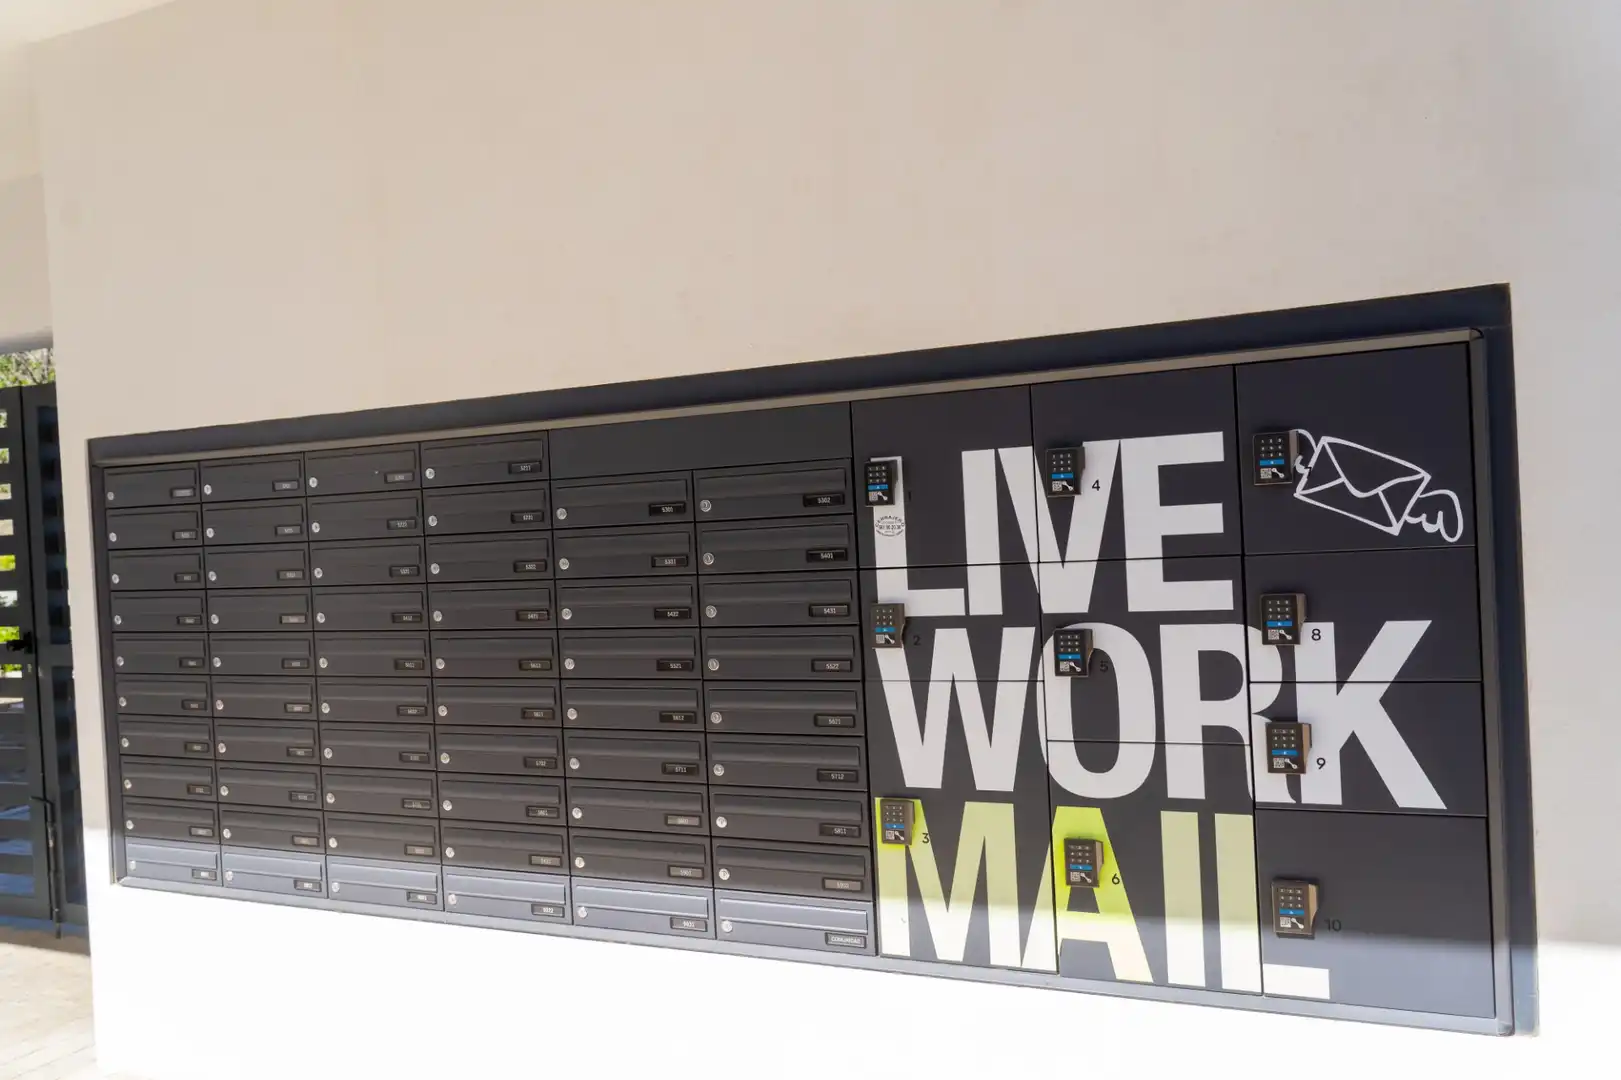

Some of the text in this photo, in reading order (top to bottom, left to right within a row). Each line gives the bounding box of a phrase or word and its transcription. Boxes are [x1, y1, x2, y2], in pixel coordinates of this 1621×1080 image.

[1091, 479, 1101, 492] 4
[817, 496, 831, 504] 5302
[871, 432, 1233, 616] LIVE
[820, 552, 834, 560] 5401
[1310, 627, 1322, 641] 8
[912, 635, 921, 646] 2
[826, 663, 840, 671] 5522
[1098, 661, 1109, 673] 5
[875, 620, 1447, 810] WORK
[828, 718, 841, 726] 5621
[1316, 757, 1327, 770] 9
[831, 773, 845, 781] 5712
[834, 828, 847, 836] 5811
[922, 832, 930, 844] 3
[1111, 873, 1121, 886] 6
[875, 797, 1330, 999] MAIL
[1323, 918, 1343, 933] 10
